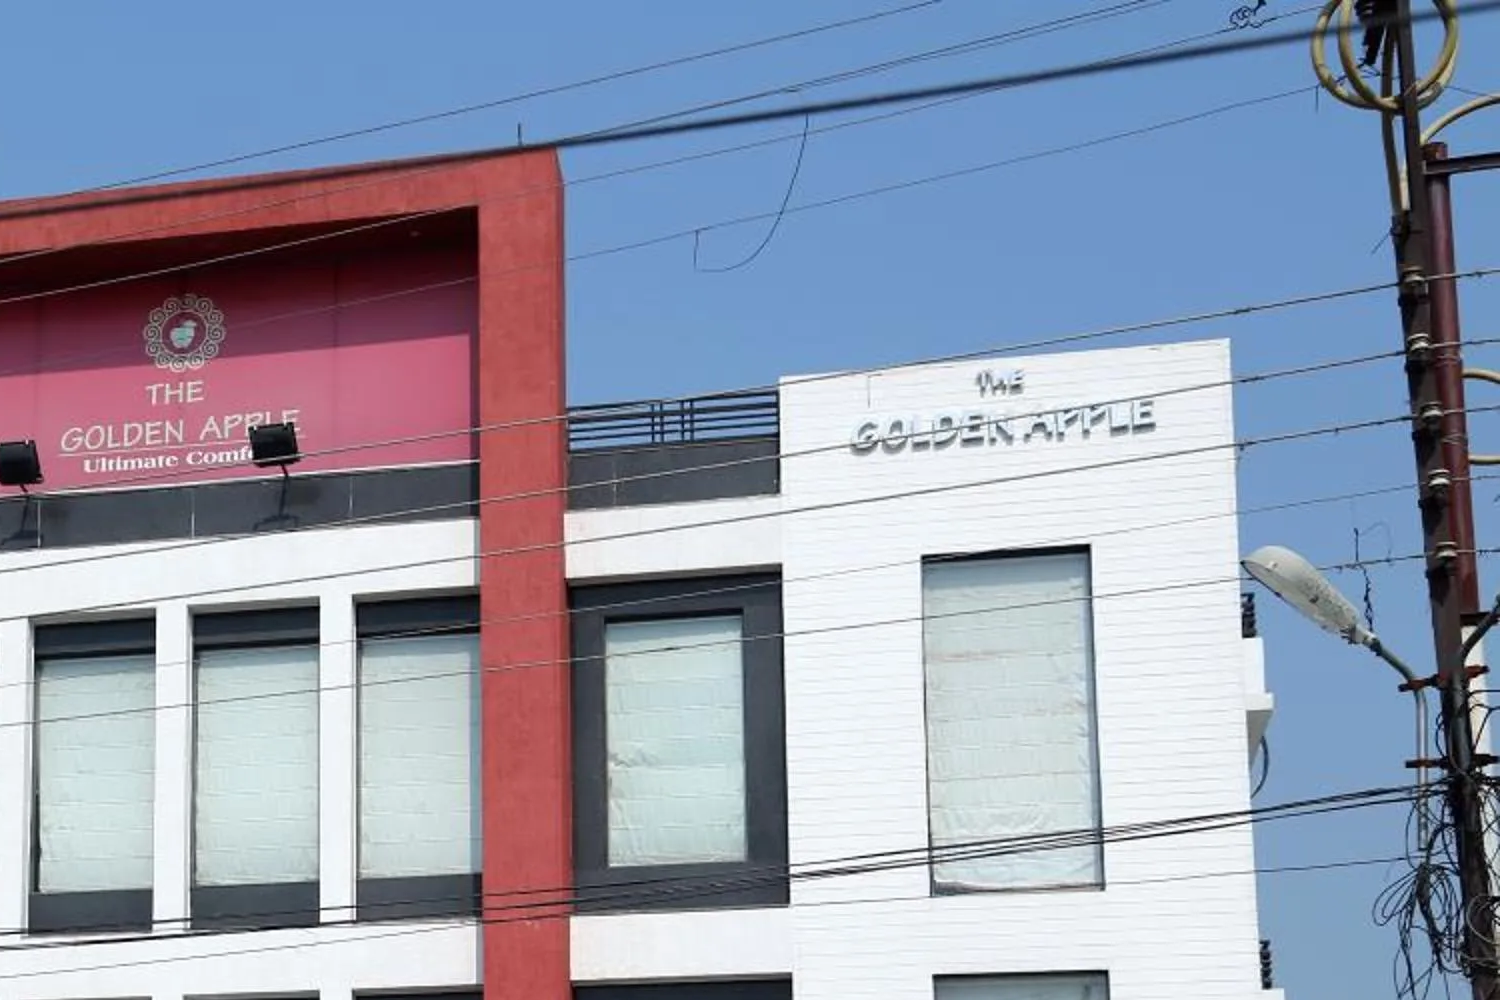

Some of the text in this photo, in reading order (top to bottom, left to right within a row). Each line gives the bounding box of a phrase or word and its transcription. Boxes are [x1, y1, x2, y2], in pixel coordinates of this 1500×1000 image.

[146, 380, 204, 405] THE
[974, 368, 1024, 398] THE
[61, 419, 184, 452] GOLDEN
[850, 399, 1157, 456] GOLDEN APPLE
[84, 445, 254, 473] Ultimate Comf
